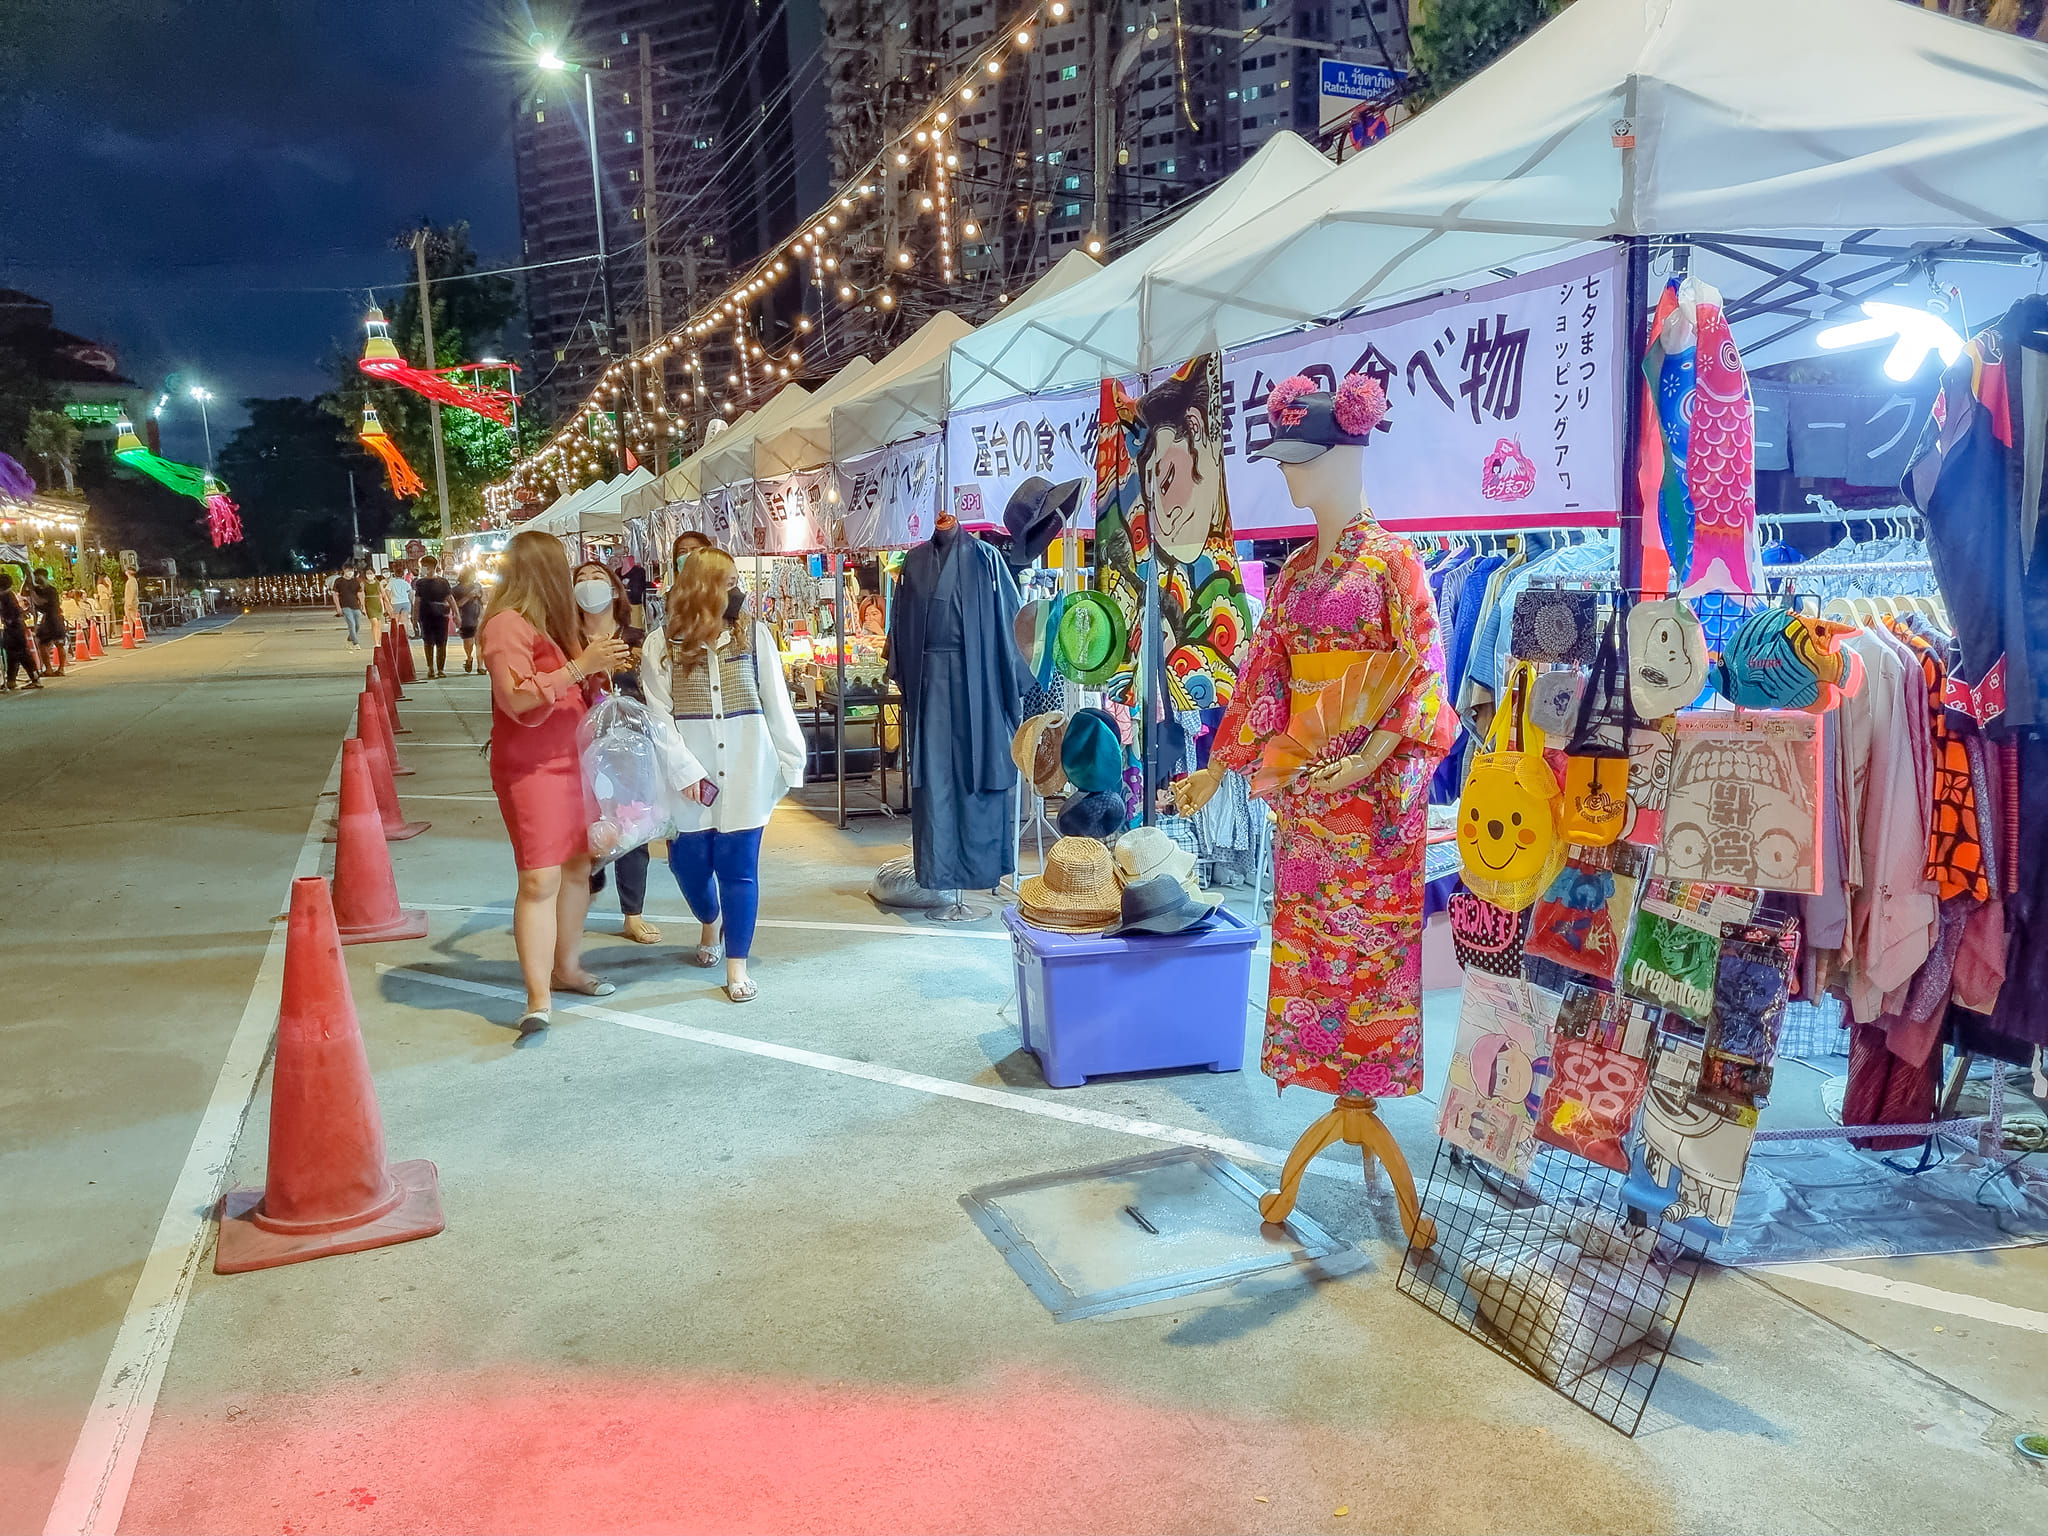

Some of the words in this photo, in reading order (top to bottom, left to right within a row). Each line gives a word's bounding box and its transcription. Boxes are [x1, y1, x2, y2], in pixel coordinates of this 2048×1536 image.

[1554, 284, 1580, 508] ショッピングアワー
[1577, 275, 1600, 410] 七夕まつり
[961, 493, 981, 511] SP1
